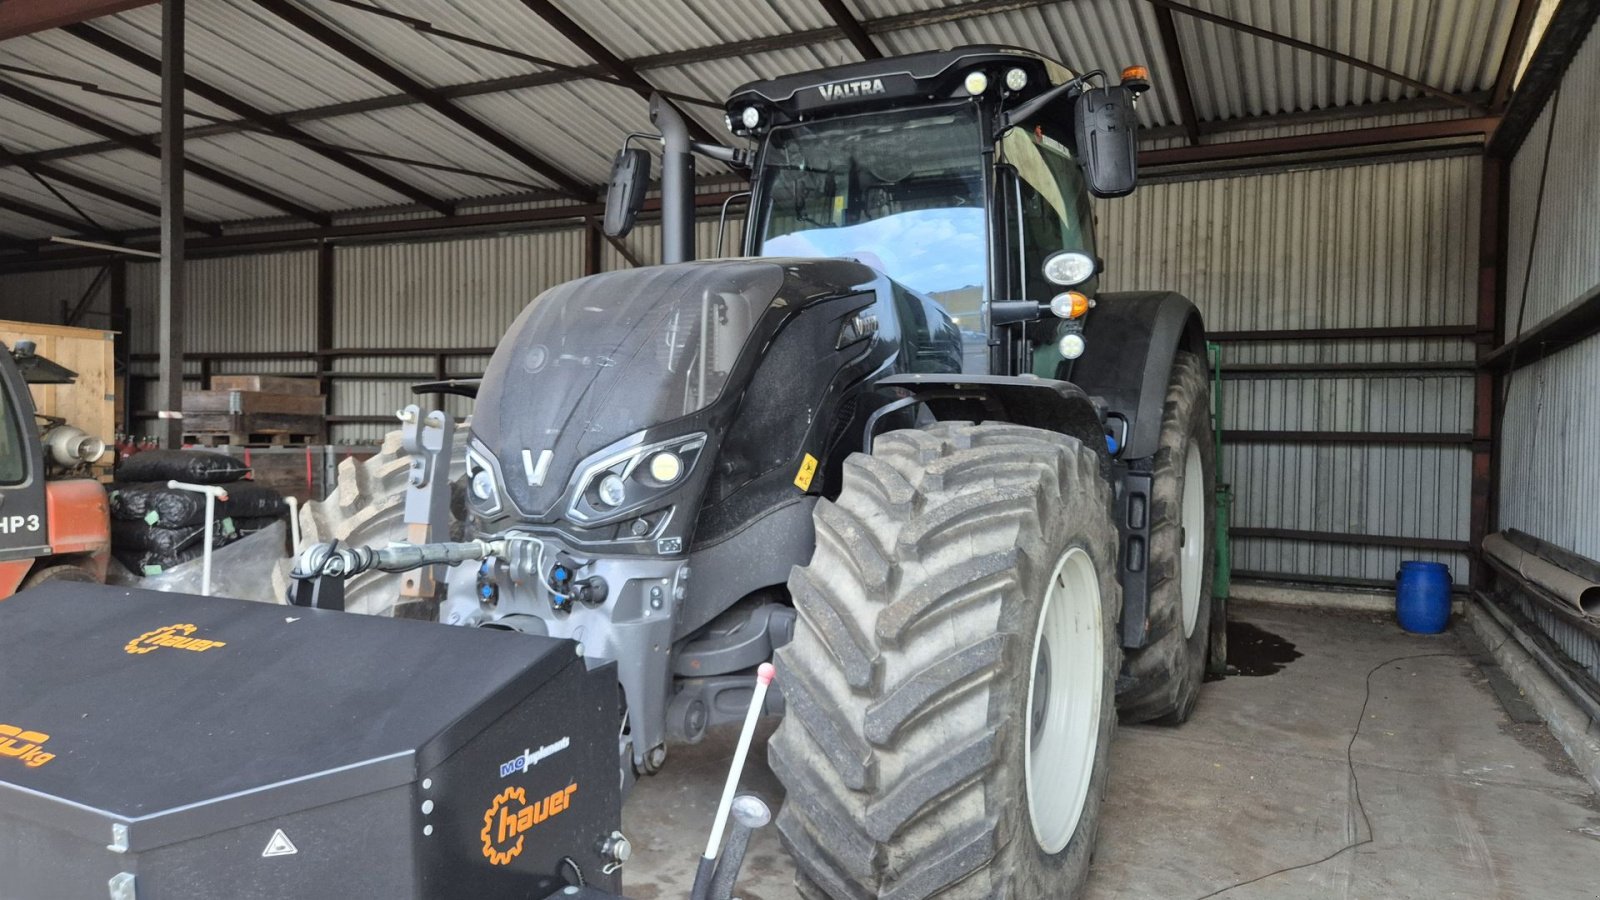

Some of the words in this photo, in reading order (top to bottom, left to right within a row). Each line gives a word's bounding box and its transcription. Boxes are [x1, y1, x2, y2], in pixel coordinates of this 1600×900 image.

[818, 79, 886, 101] VALTRA
[521, 449, 554, 487] V
[141, 628, 227, 653] hauer
[497, 783, 578, 843] hauer
